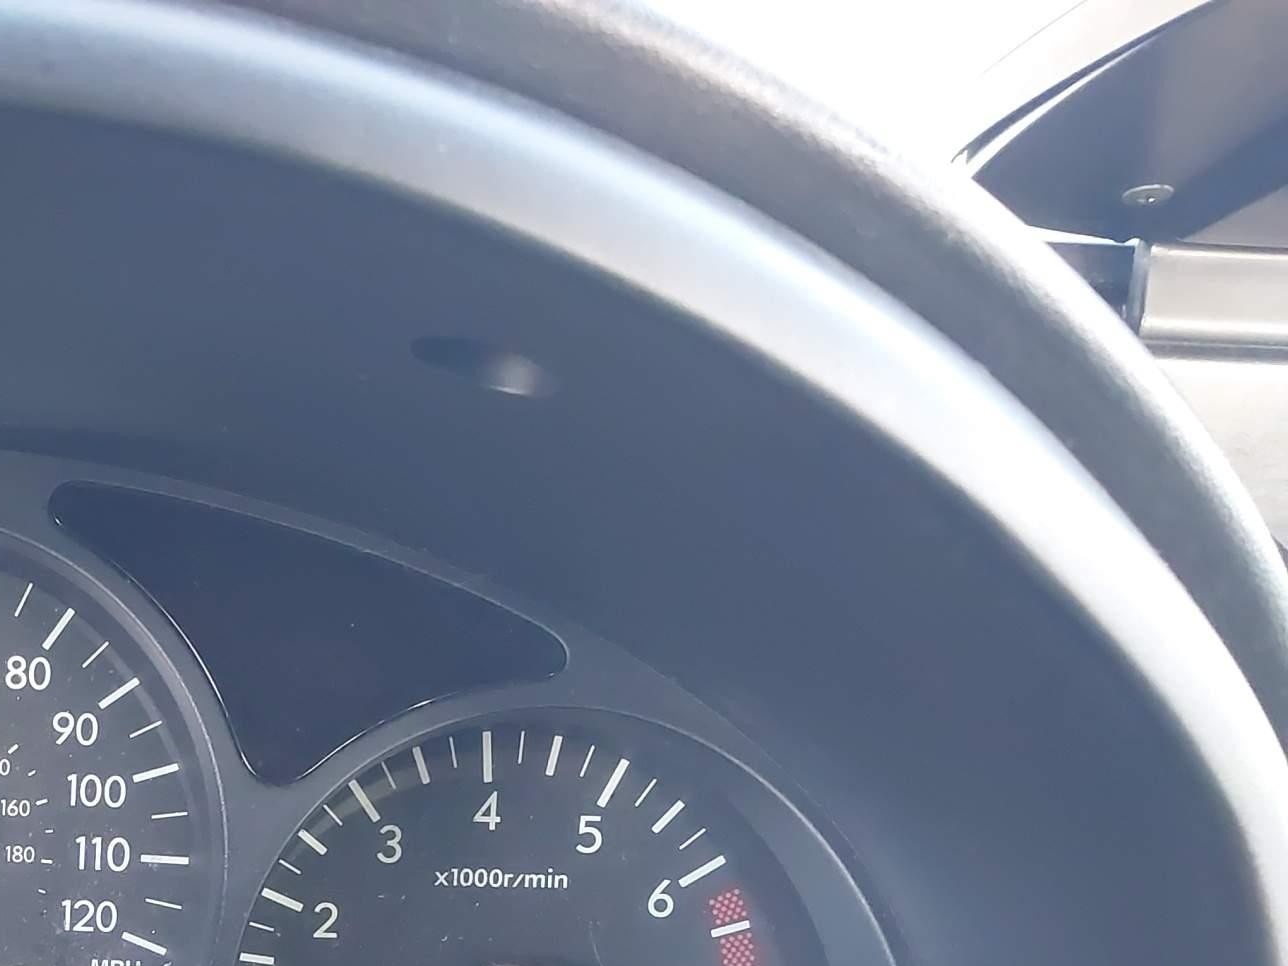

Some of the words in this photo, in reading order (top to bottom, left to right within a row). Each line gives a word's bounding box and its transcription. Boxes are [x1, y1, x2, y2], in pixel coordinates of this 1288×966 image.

[5, 656, 51, 690] 80
[52, 711, 99, 745] 90
[0, 799, 30, 817] 160
[67, 774, 126, 808] 100
[474, 792, 500, 830] 4
[377, 825, 402, 864] 3
[576, 816, 602, 854] 5
[5, 845, 34, 863] 180
[75, 837, 129, 871] 110
[434, 867, 568, 890] x1000r/min
[648, 878, 674, 918] 6
[63, 899, 117, 933] 120
[313, 904, 338, 938] 2
